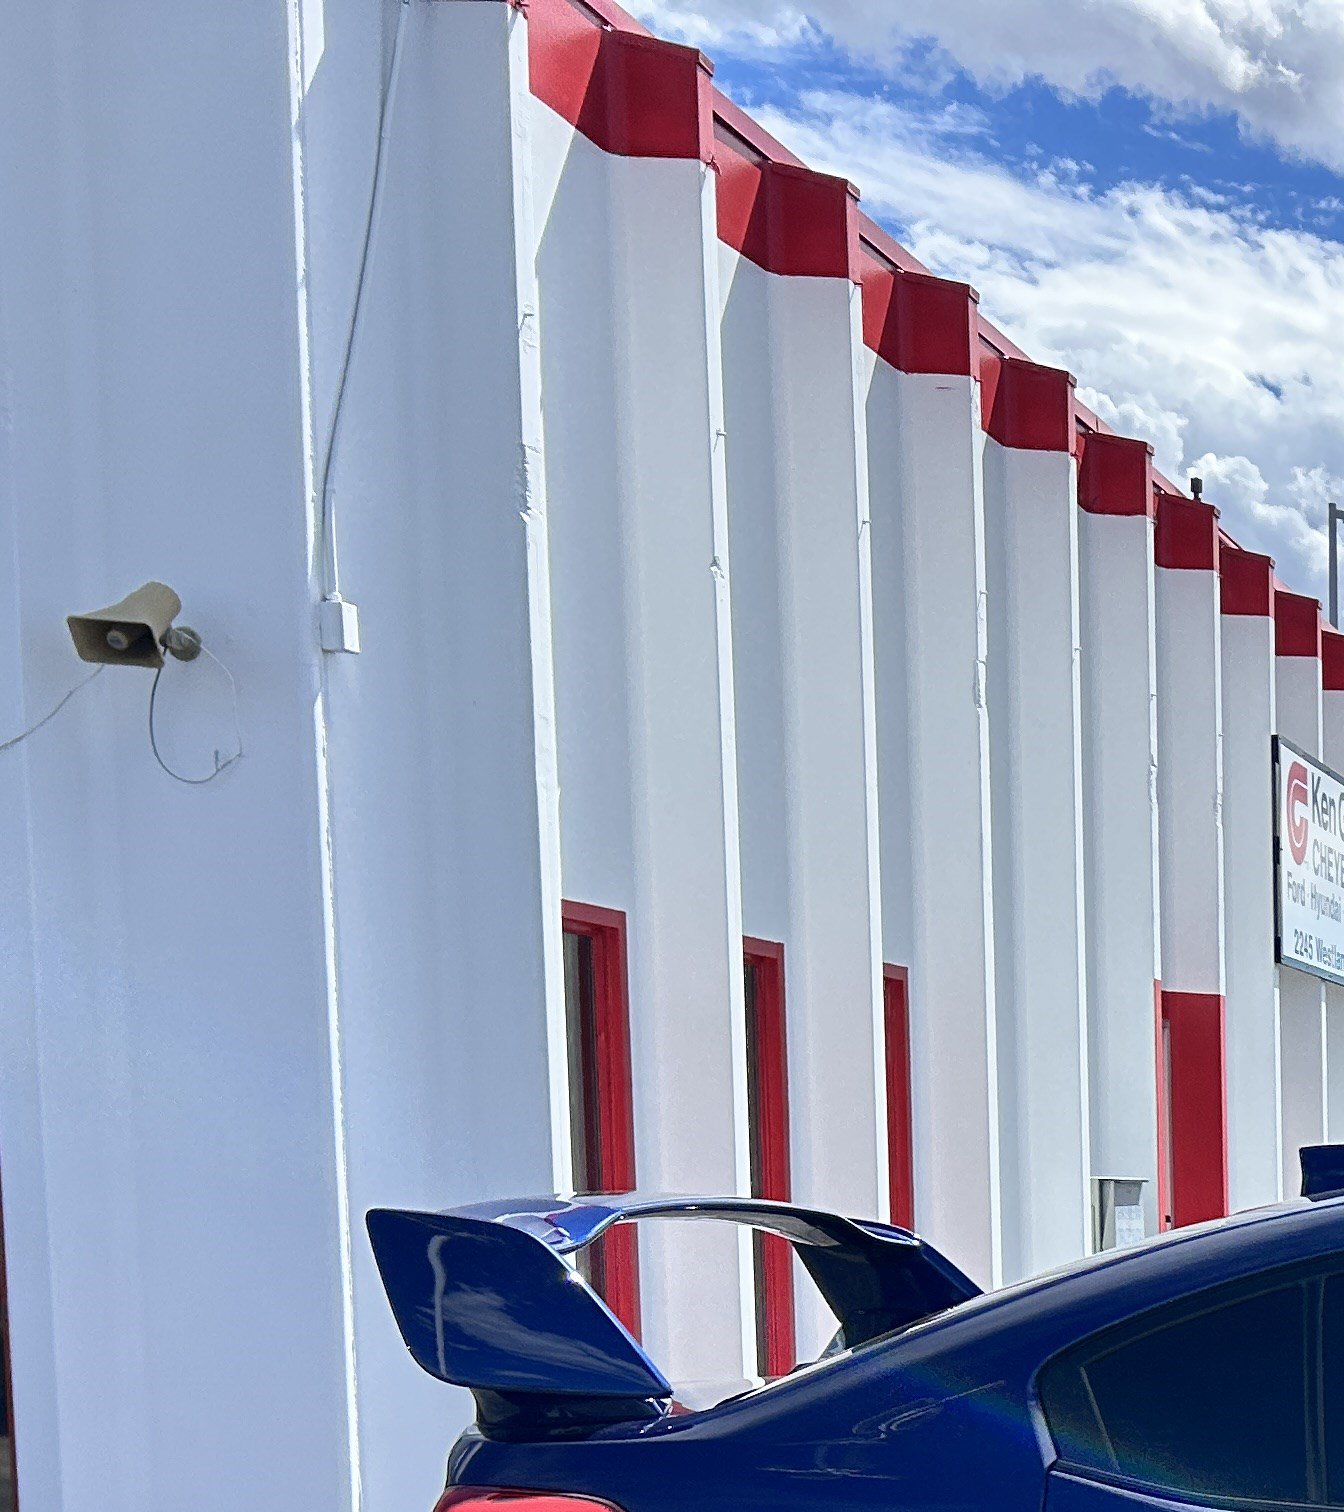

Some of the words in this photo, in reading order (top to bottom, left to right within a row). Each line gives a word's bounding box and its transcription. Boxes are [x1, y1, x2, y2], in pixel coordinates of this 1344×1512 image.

[1311, 772, 1336, 836] Ken
[1287, 870, 1305, 906] Ford
[1311, 882, 1341, 923] Hyundai
[1294, 928, 1313, 960] 2245
